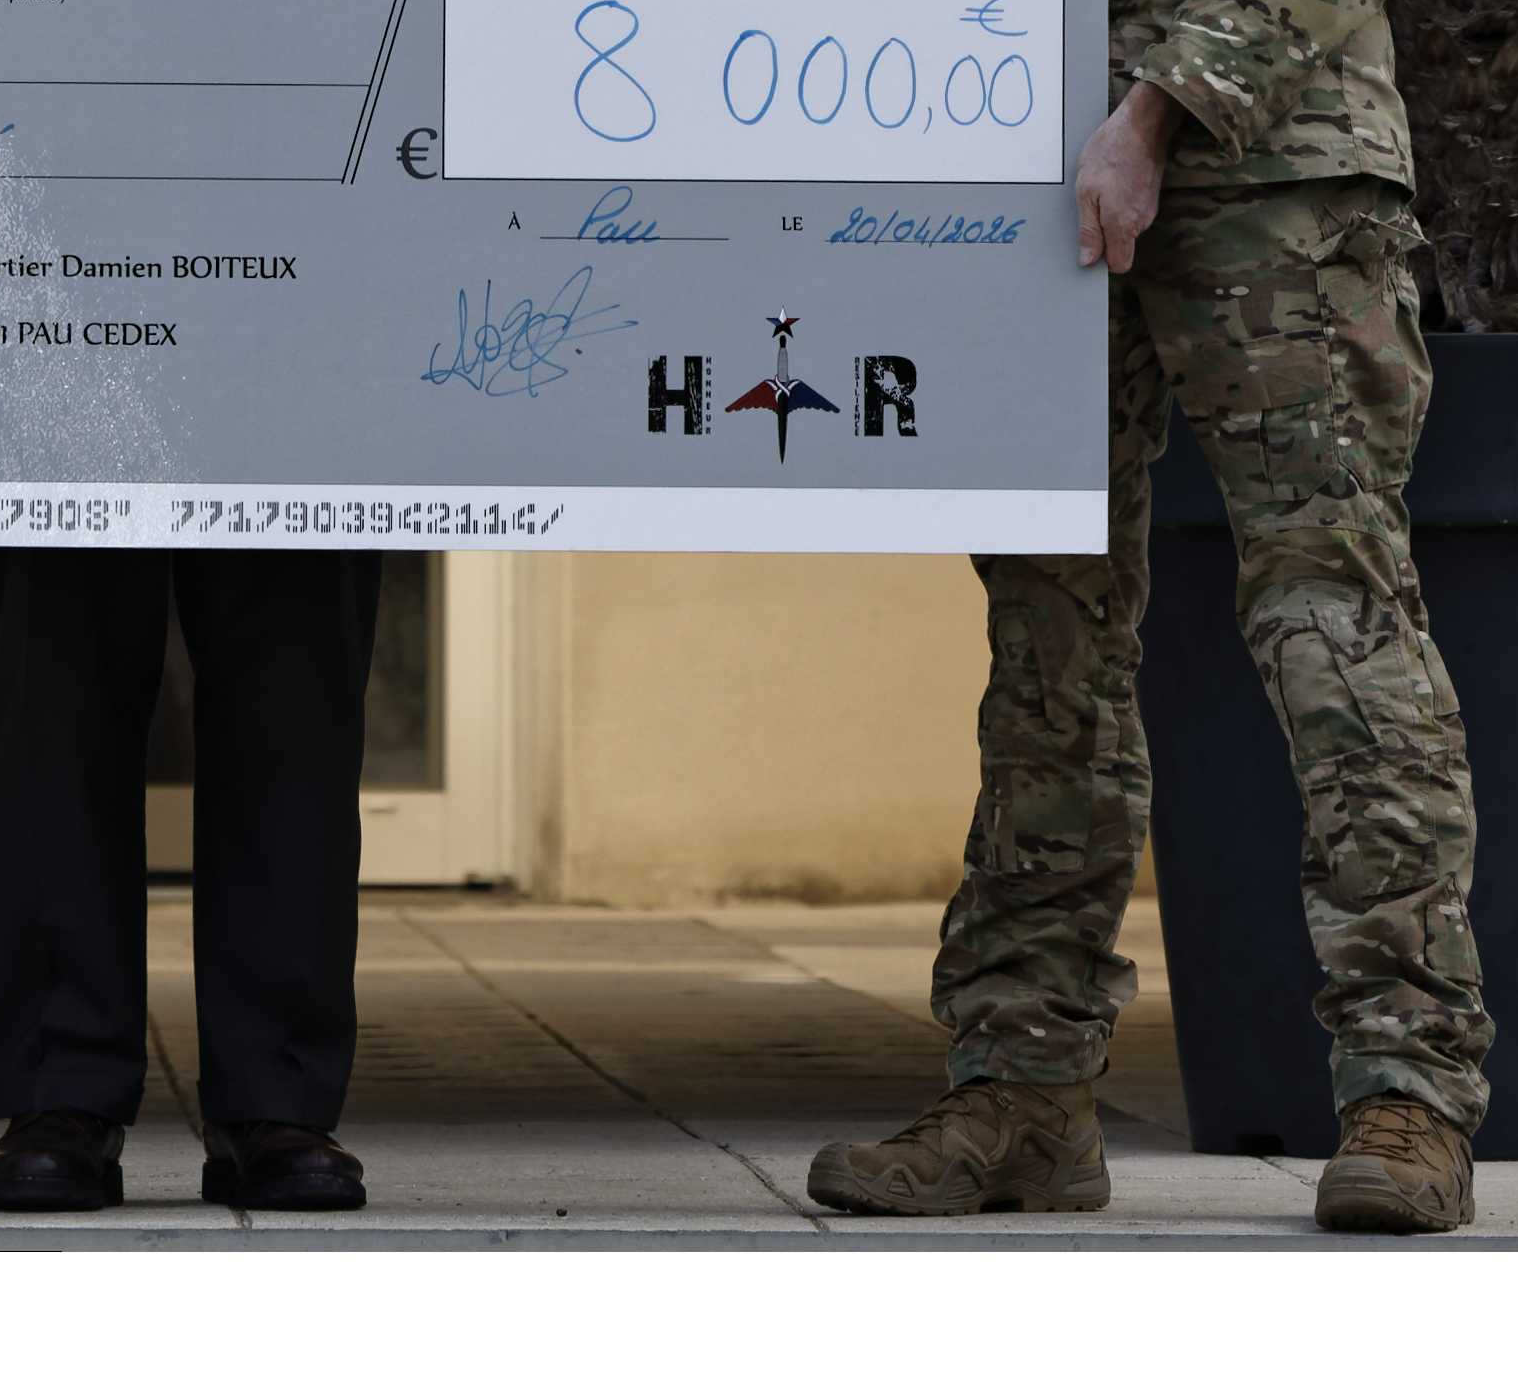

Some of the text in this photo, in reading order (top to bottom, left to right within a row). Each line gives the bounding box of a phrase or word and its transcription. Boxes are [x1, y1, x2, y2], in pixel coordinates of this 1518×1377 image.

[722, 29, 1035, 135] 000,00
[395, 126, 439, 180] €
[507, 210, 521, 231] À
[576, 185, 662, 246] Pau
[781, 215, 804, 232] LE
[829, 206, 1028, 248] 20/04/2026
[61, 254, 164, 280] Damien
[171, 255, 298, 282] BOITEUX
[17, 321, 74, 347] PAU
[82, 321, 178, 347] CEDEX
[647, 354, 703, 435] H
[863, 355, 919, 437] R
